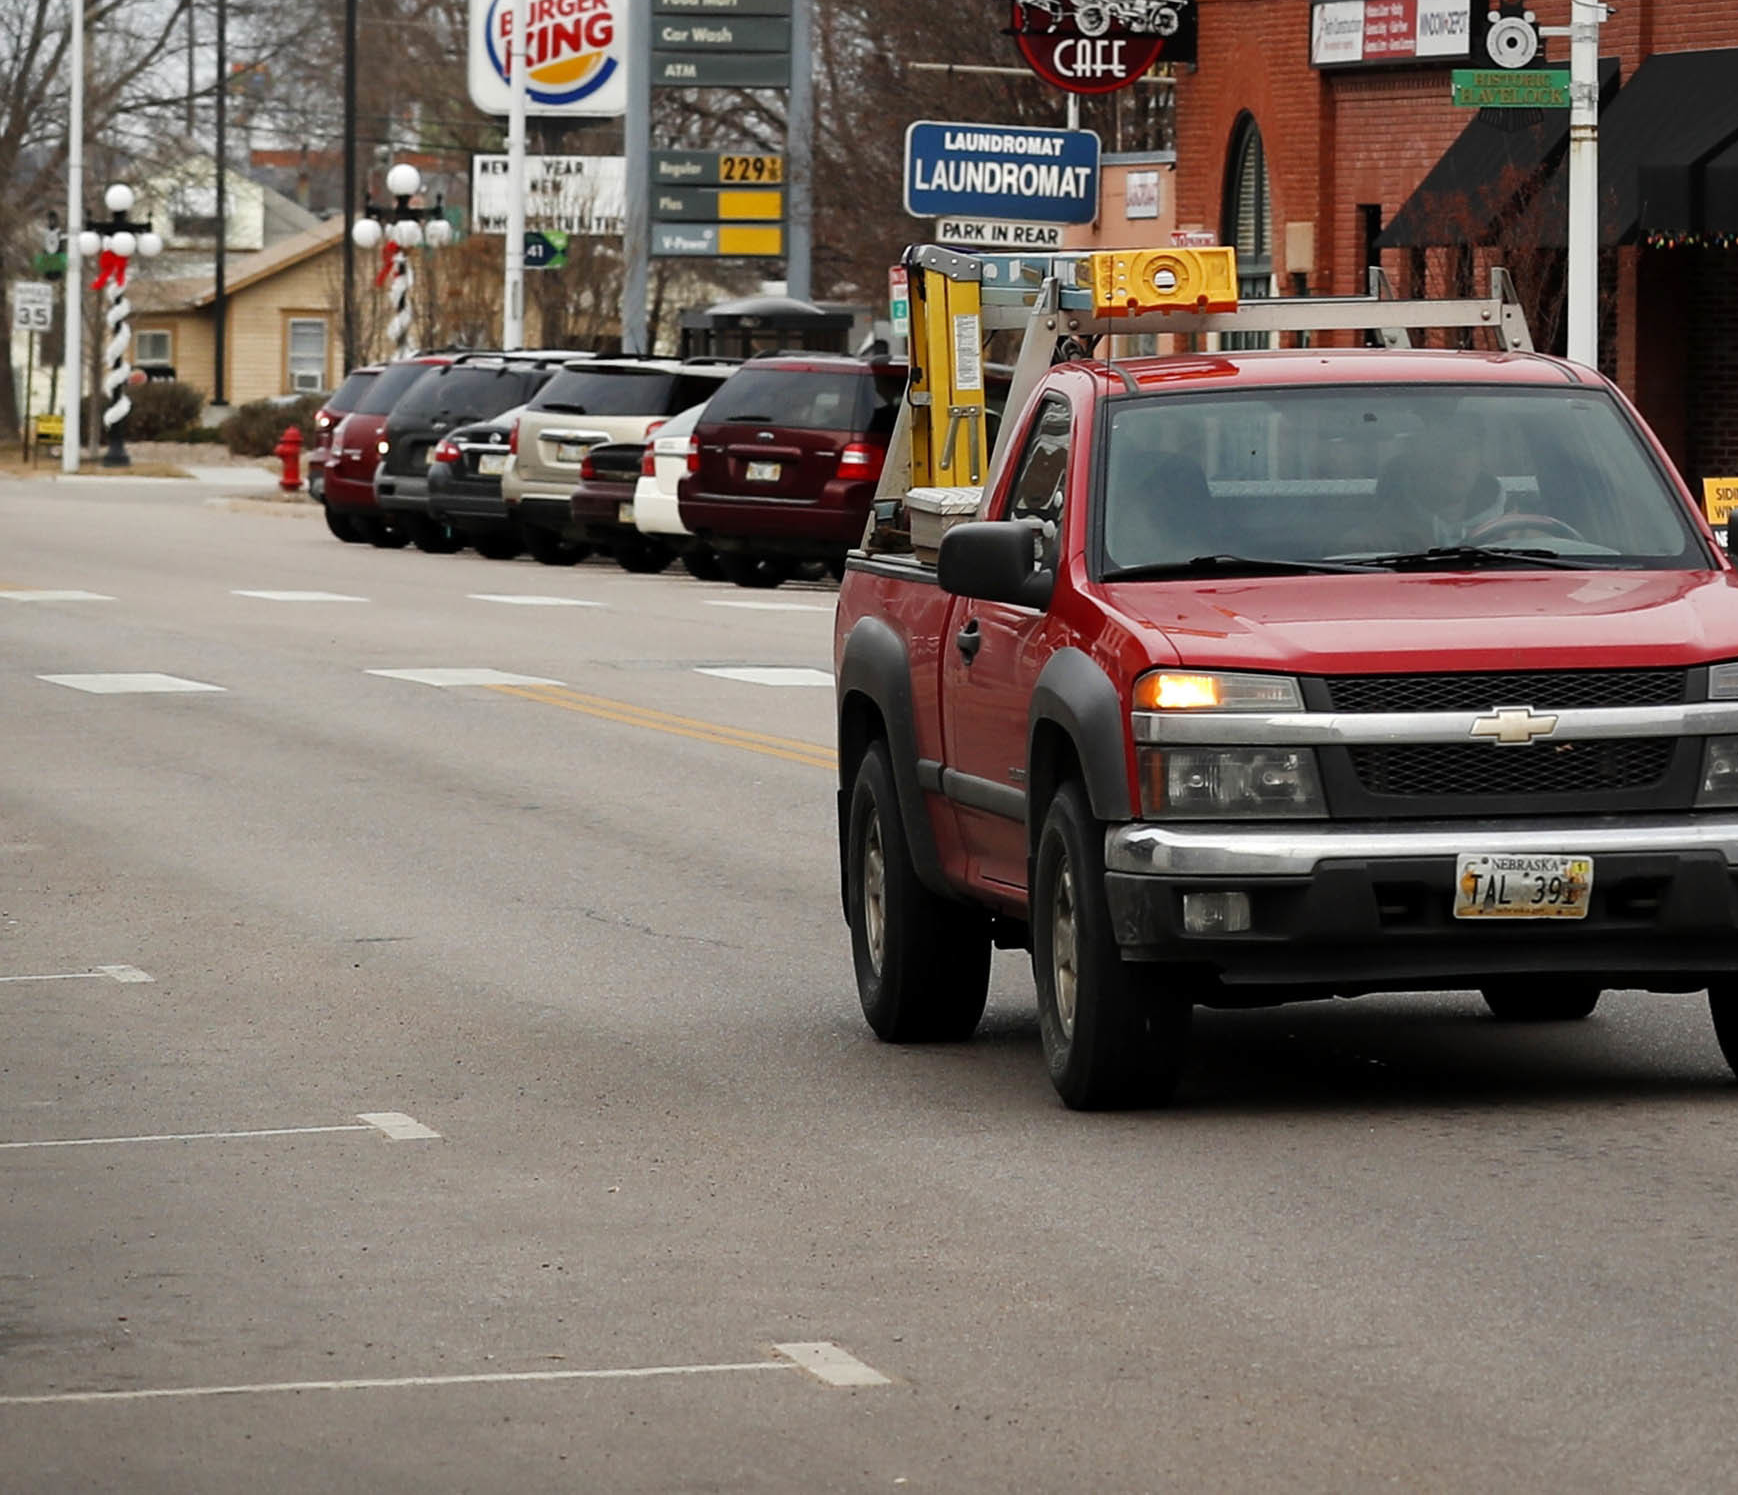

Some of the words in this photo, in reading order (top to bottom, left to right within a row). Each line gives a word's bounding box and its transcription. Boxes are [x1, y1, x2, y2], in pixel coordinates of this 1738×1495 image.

[662, 27, 688, 42] Car
[692, 27, 733, 42] Wash
[1053, 39, 1127, 78] CAFE
[664, 64, 697, 77] ATM
[1474, 73, 1552, 87] HISTORIC
[1460, 88, 1565, 104] HAVELOCK
[944, 131, 1064, 157] LAUNDROMAT
[543, 161, 585, 174] YEAR
[723, 157, 766, 181] 229
[914, 159, 1091, 199] LAUNDROMAT
[942, 222, 985, 241] PARK
[992, 225, 1008, 241] IN
[1013, 226, 1059, 245] REAR
[18, 307, 48, 326] 35
[1491, 858, 1560, 872] NEBRASKA
[1470, 874, 1511, 905] TAL
